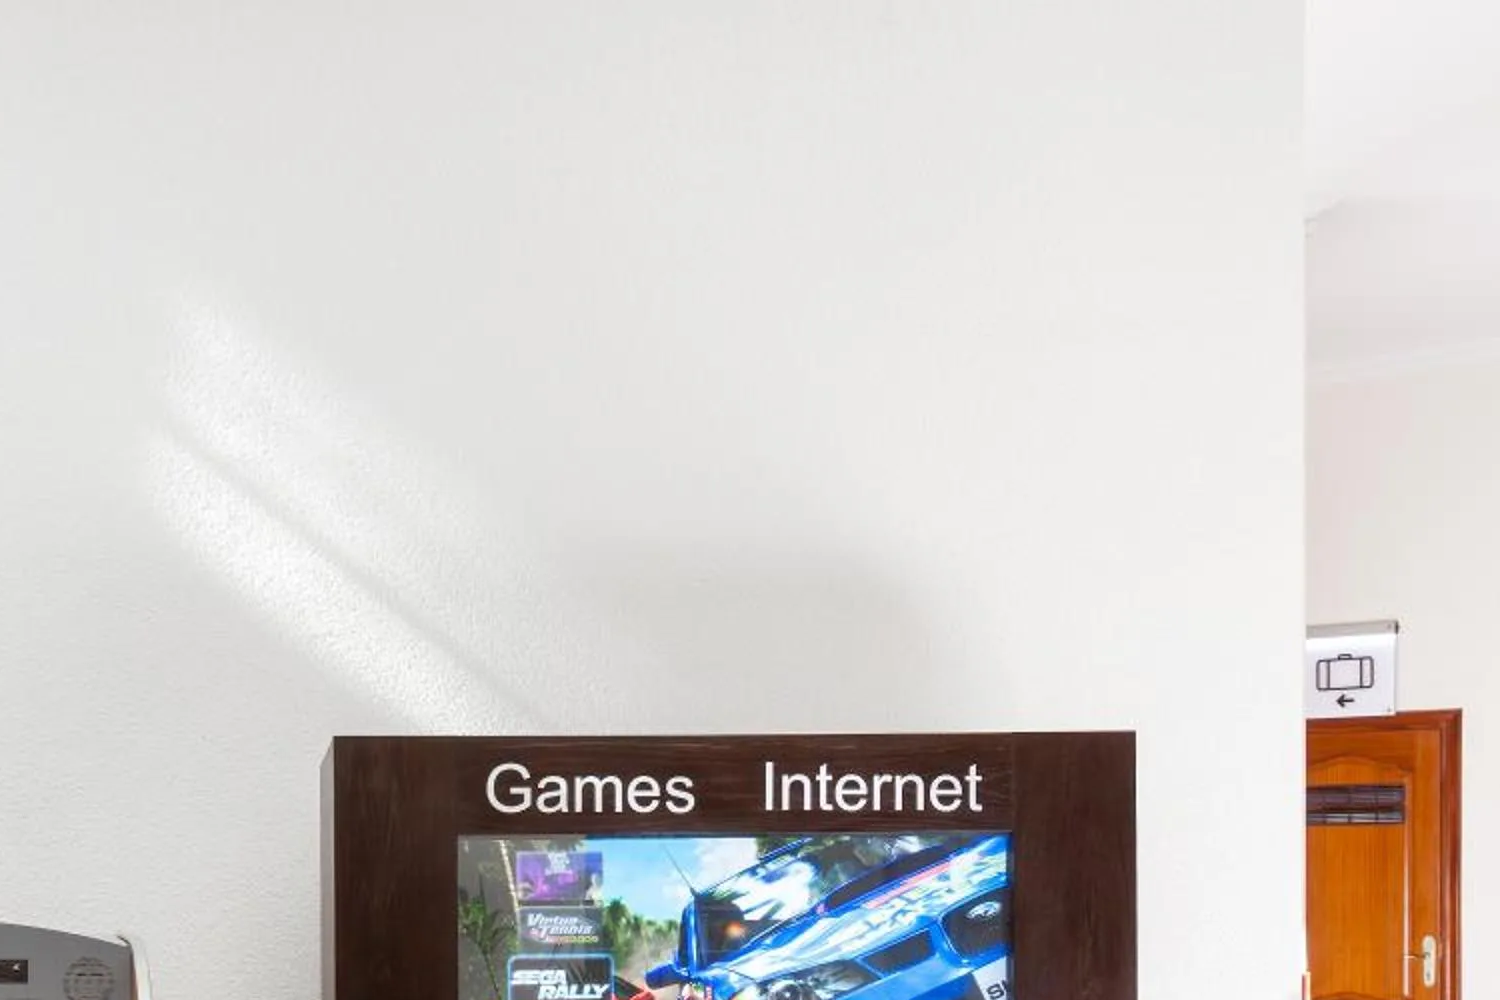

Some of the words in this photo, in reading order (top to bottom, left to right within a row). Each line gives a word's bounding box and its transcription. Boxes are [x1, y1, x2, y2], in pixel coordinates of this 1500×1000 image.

[485, 762, 696, 813] Games
[764, 761, 984, 812] Internet
[511, 969, 567, 985] SEGA
[537, 984, 610, 1000] RALLY
